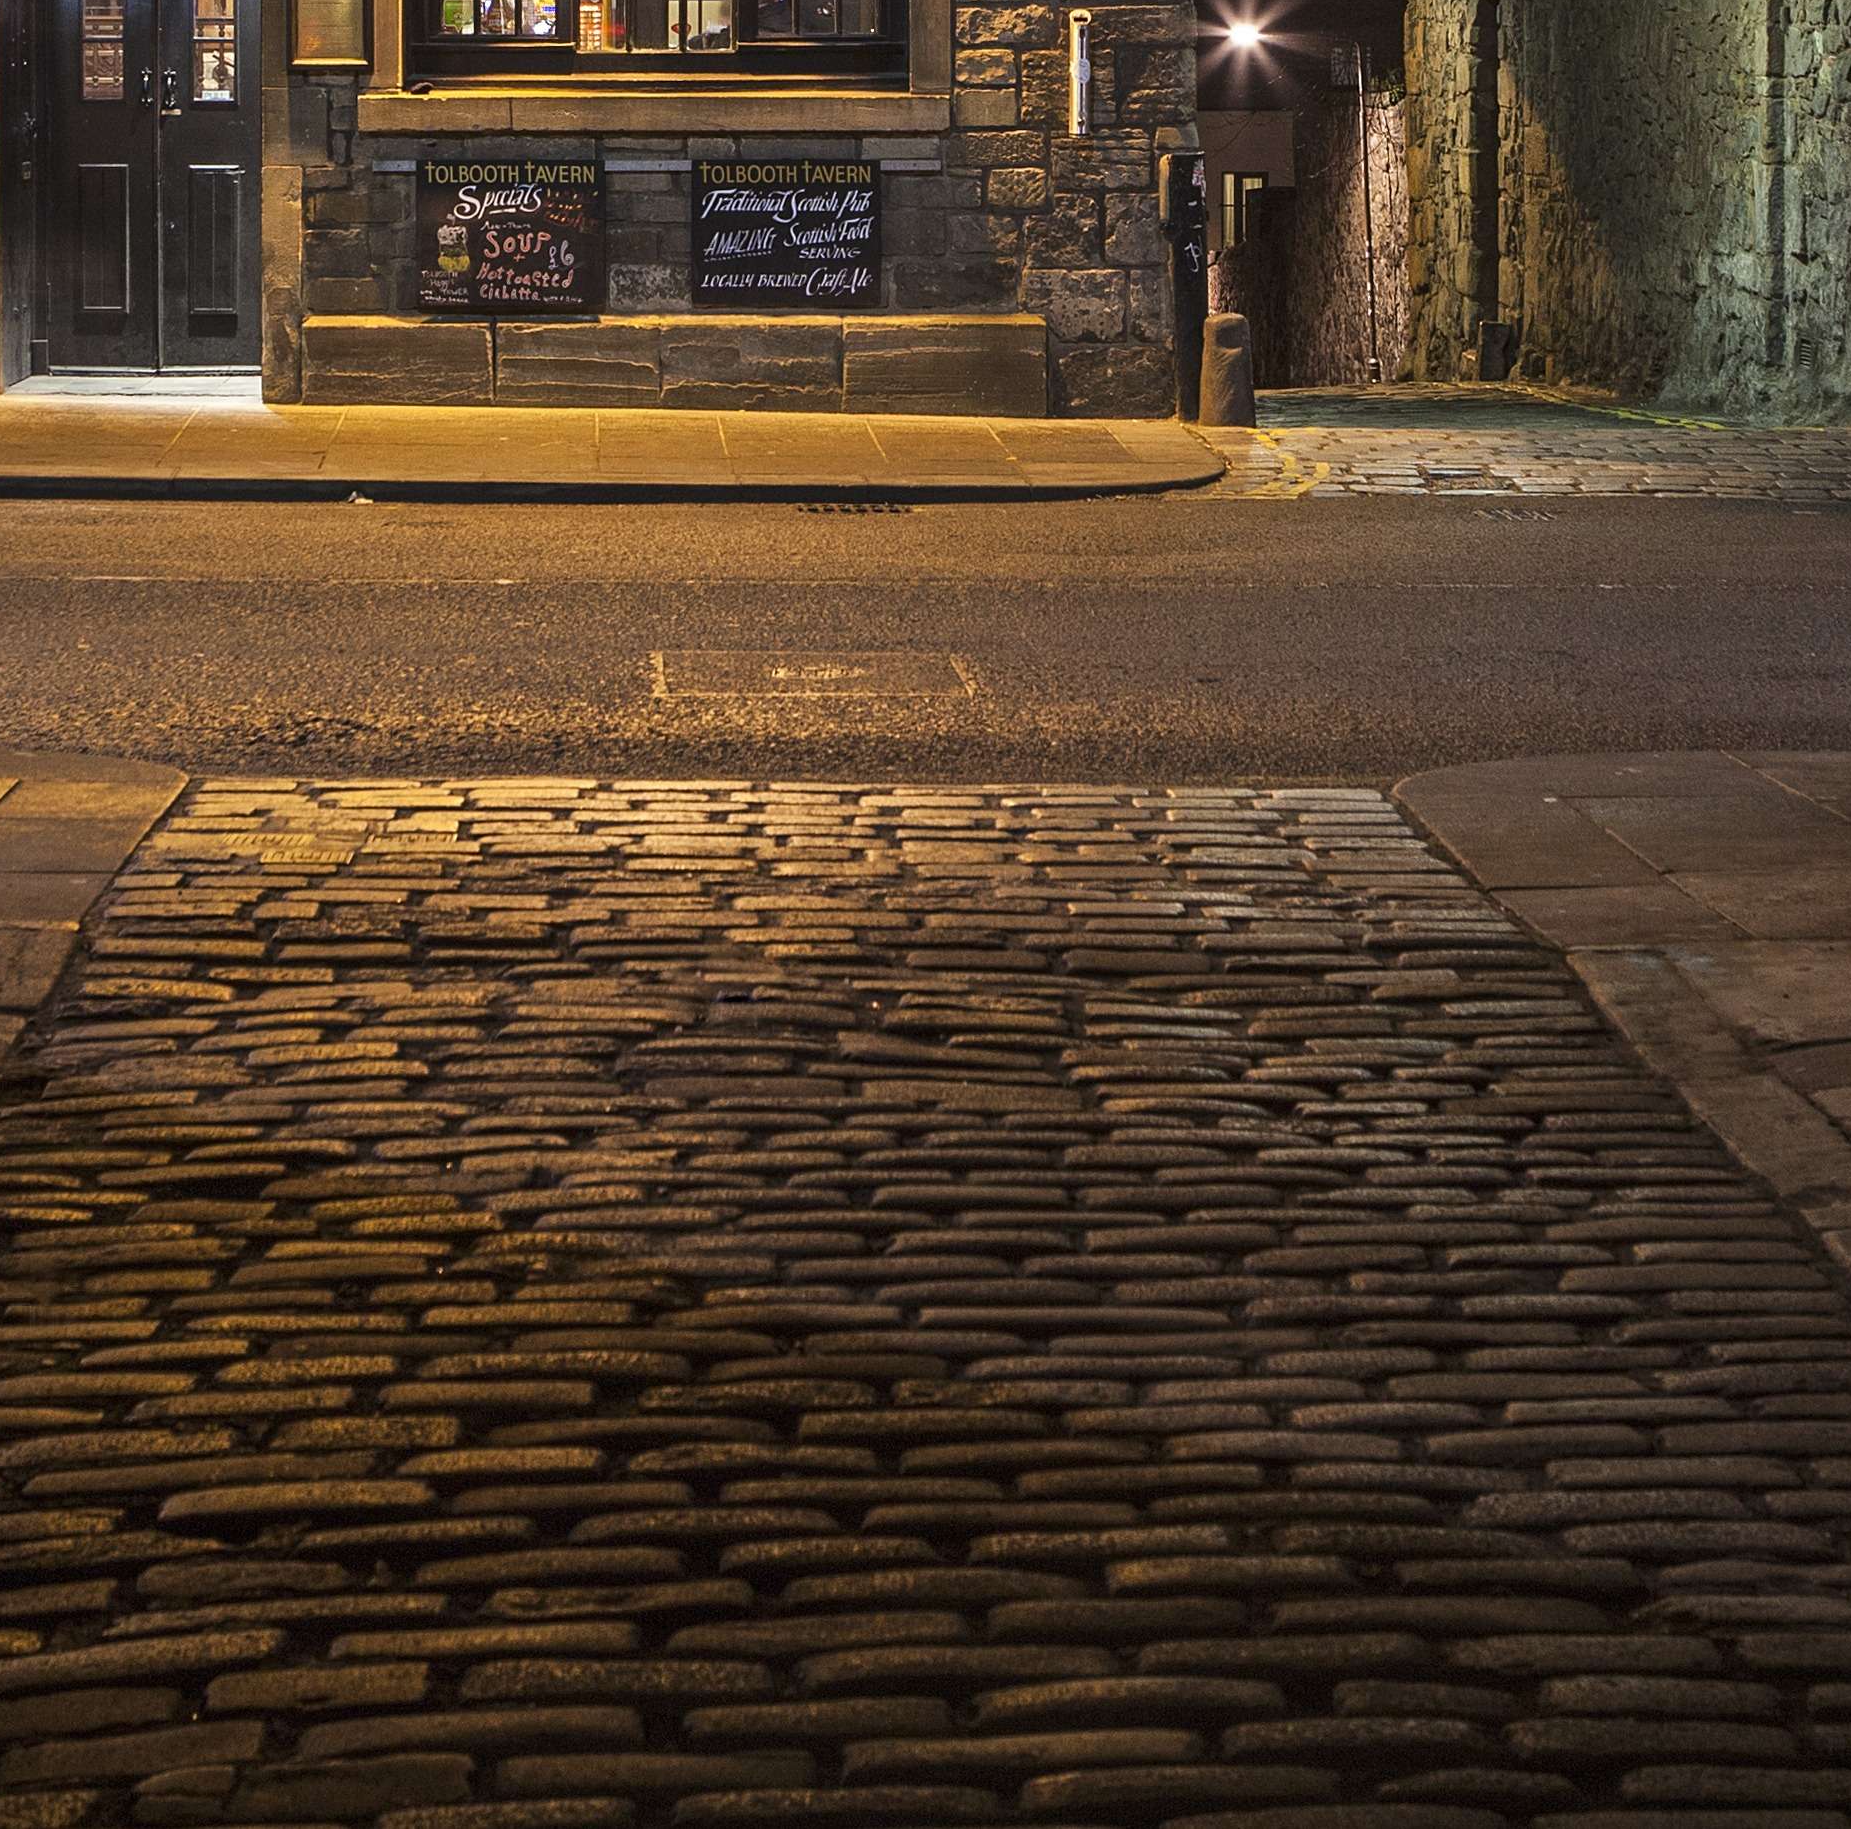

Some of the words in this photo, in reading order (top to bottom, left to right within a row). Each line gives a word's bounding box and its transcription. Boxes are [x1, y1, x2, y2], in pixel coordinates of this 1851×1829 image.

[425, 161, 519, 184] TOLBOOTH
[524, 161, 595, 184] TAVERN
[699, 161, 798, 184] TOLBOOTH
[801, 161, 871, 184] TAVERN
[454, 183, 542, 220] Specials
[701, 188, 793, 219] Traditional
[772, 188, 839, 223] Scottish
[835, 190, 873, 220] Pub
[703, 226, 777, 257] AMAZING
[783, 221, 836, 247] Scottish
[837, 216, 875, 242] Food
[799, 245, 862, 259] SERVING
[700, 273, 755, 288] LOCALLY
[757, 273, 807, 288] BREWED
[805, 267, 847, 297] Craft
